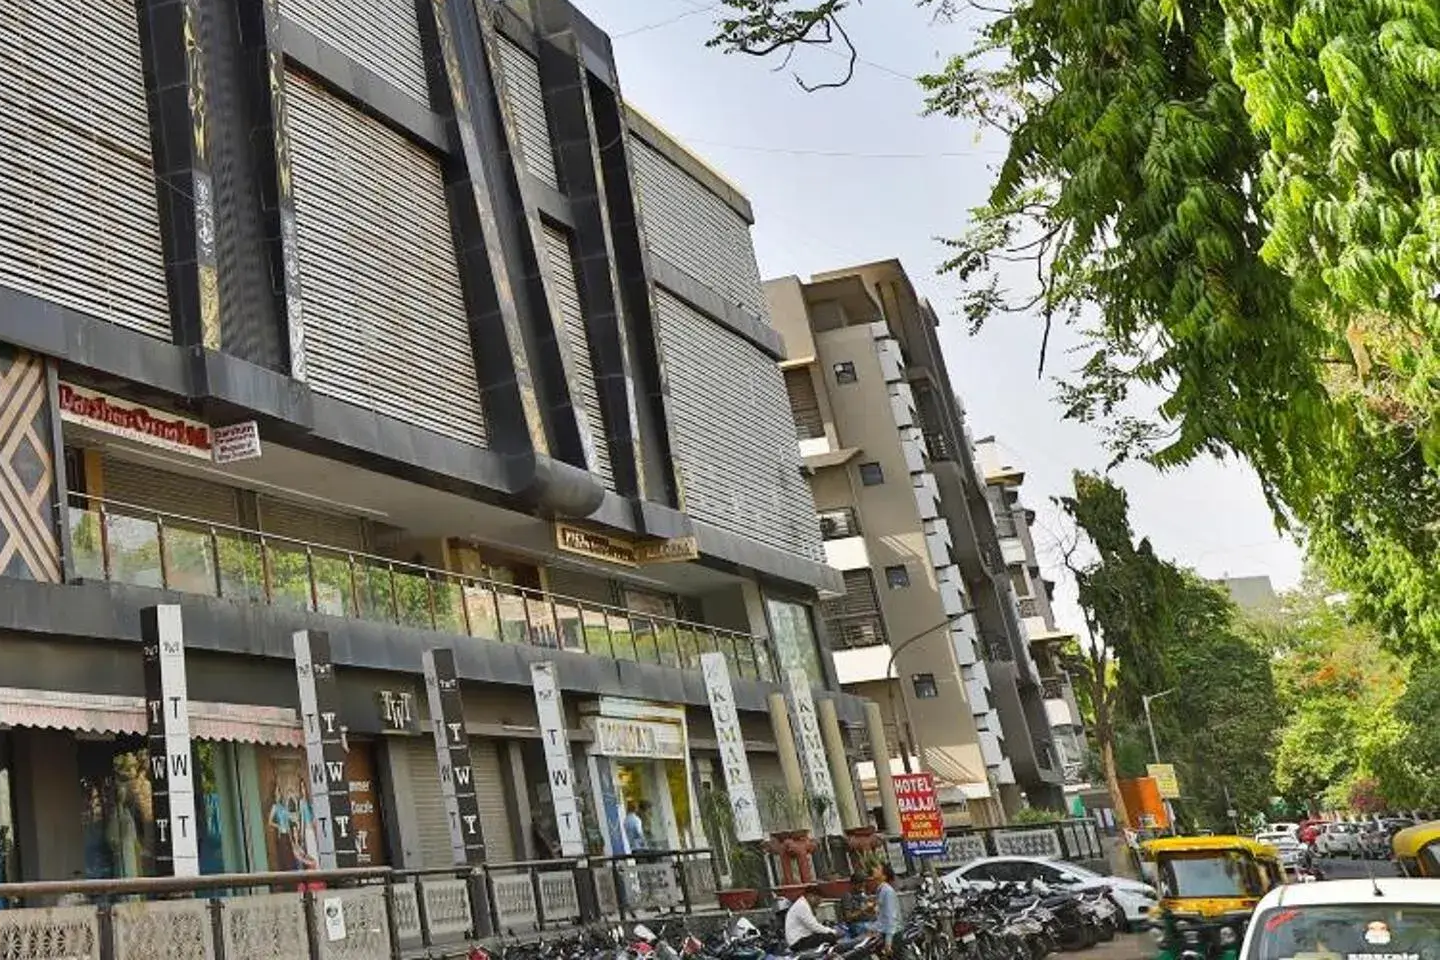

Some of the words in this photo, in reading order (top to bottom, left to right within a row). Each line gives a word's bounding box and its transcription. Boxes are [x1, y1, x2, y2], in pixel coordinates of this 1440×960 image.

[381, 690, 412, 729] TWT
[894, 777, 932, 794] HOTEL
[898, 797, 936, 812] BALAJI
